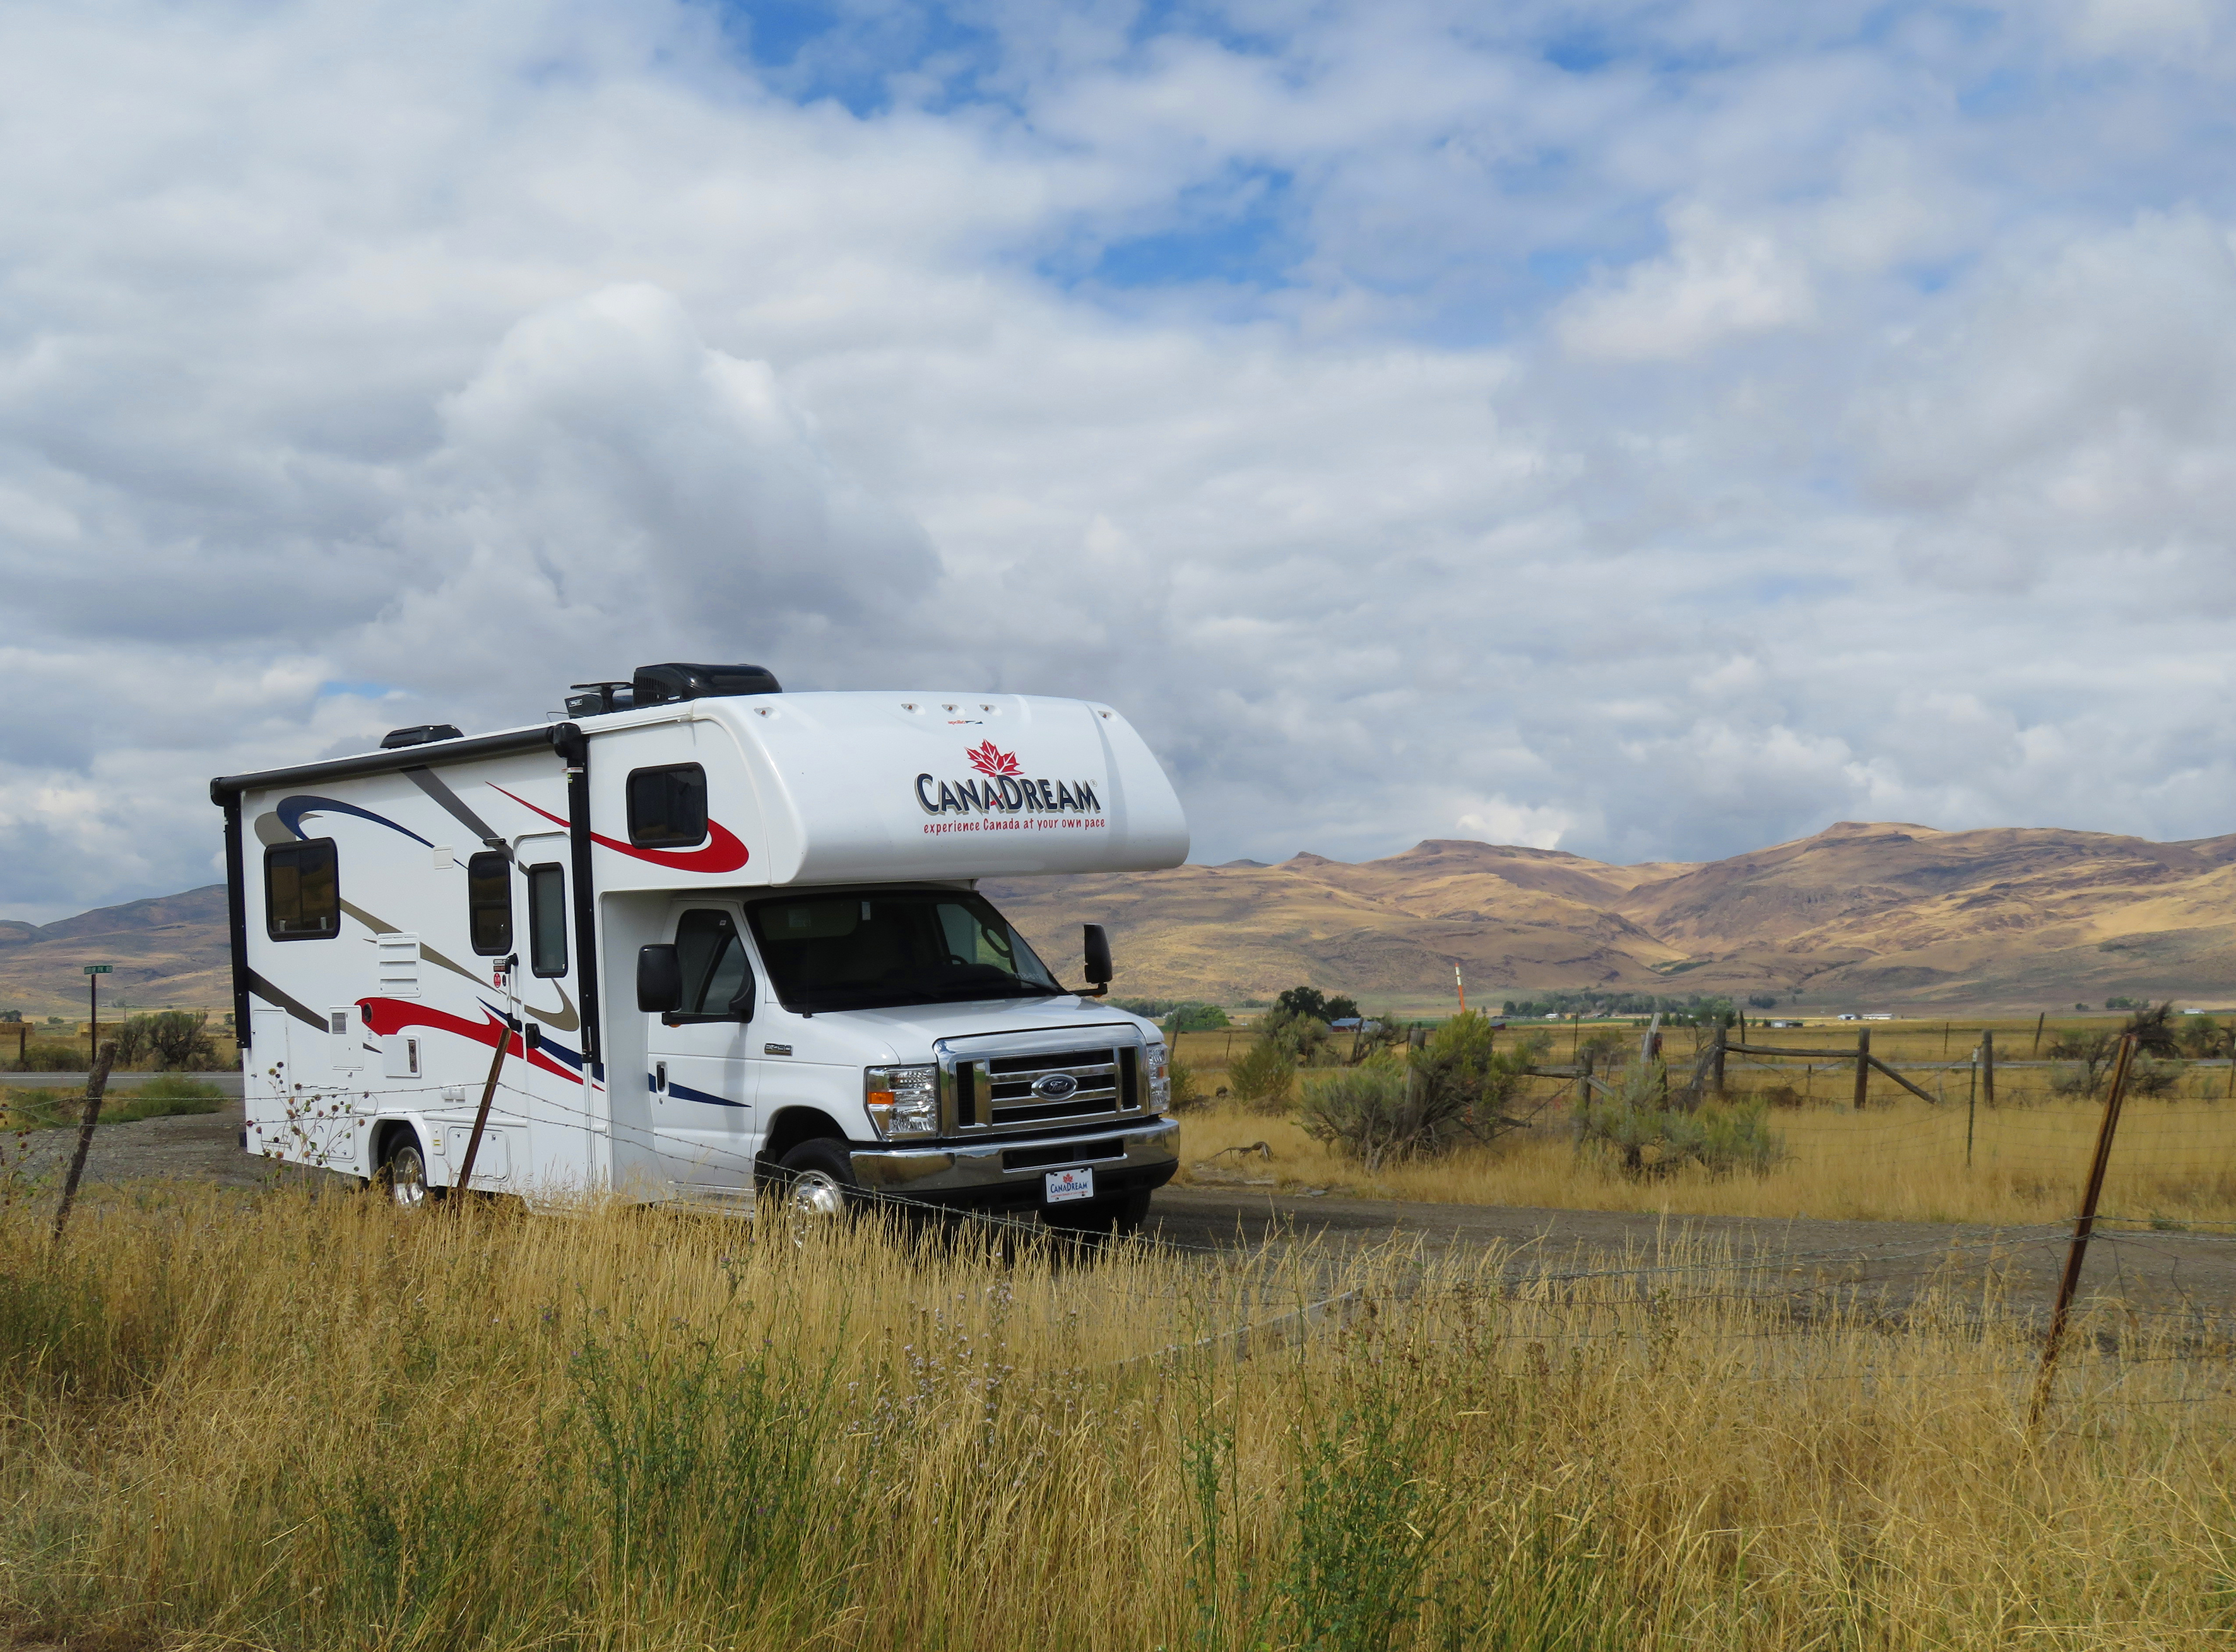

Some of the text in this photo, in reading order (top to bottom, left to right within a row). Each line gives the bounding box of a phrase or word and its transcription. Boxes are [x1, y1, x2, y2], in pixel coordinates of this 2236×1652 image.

[923, 818, 1105, 836] experience Canada at your own pace
[1048, 1080, 1068, 1092] Ford
